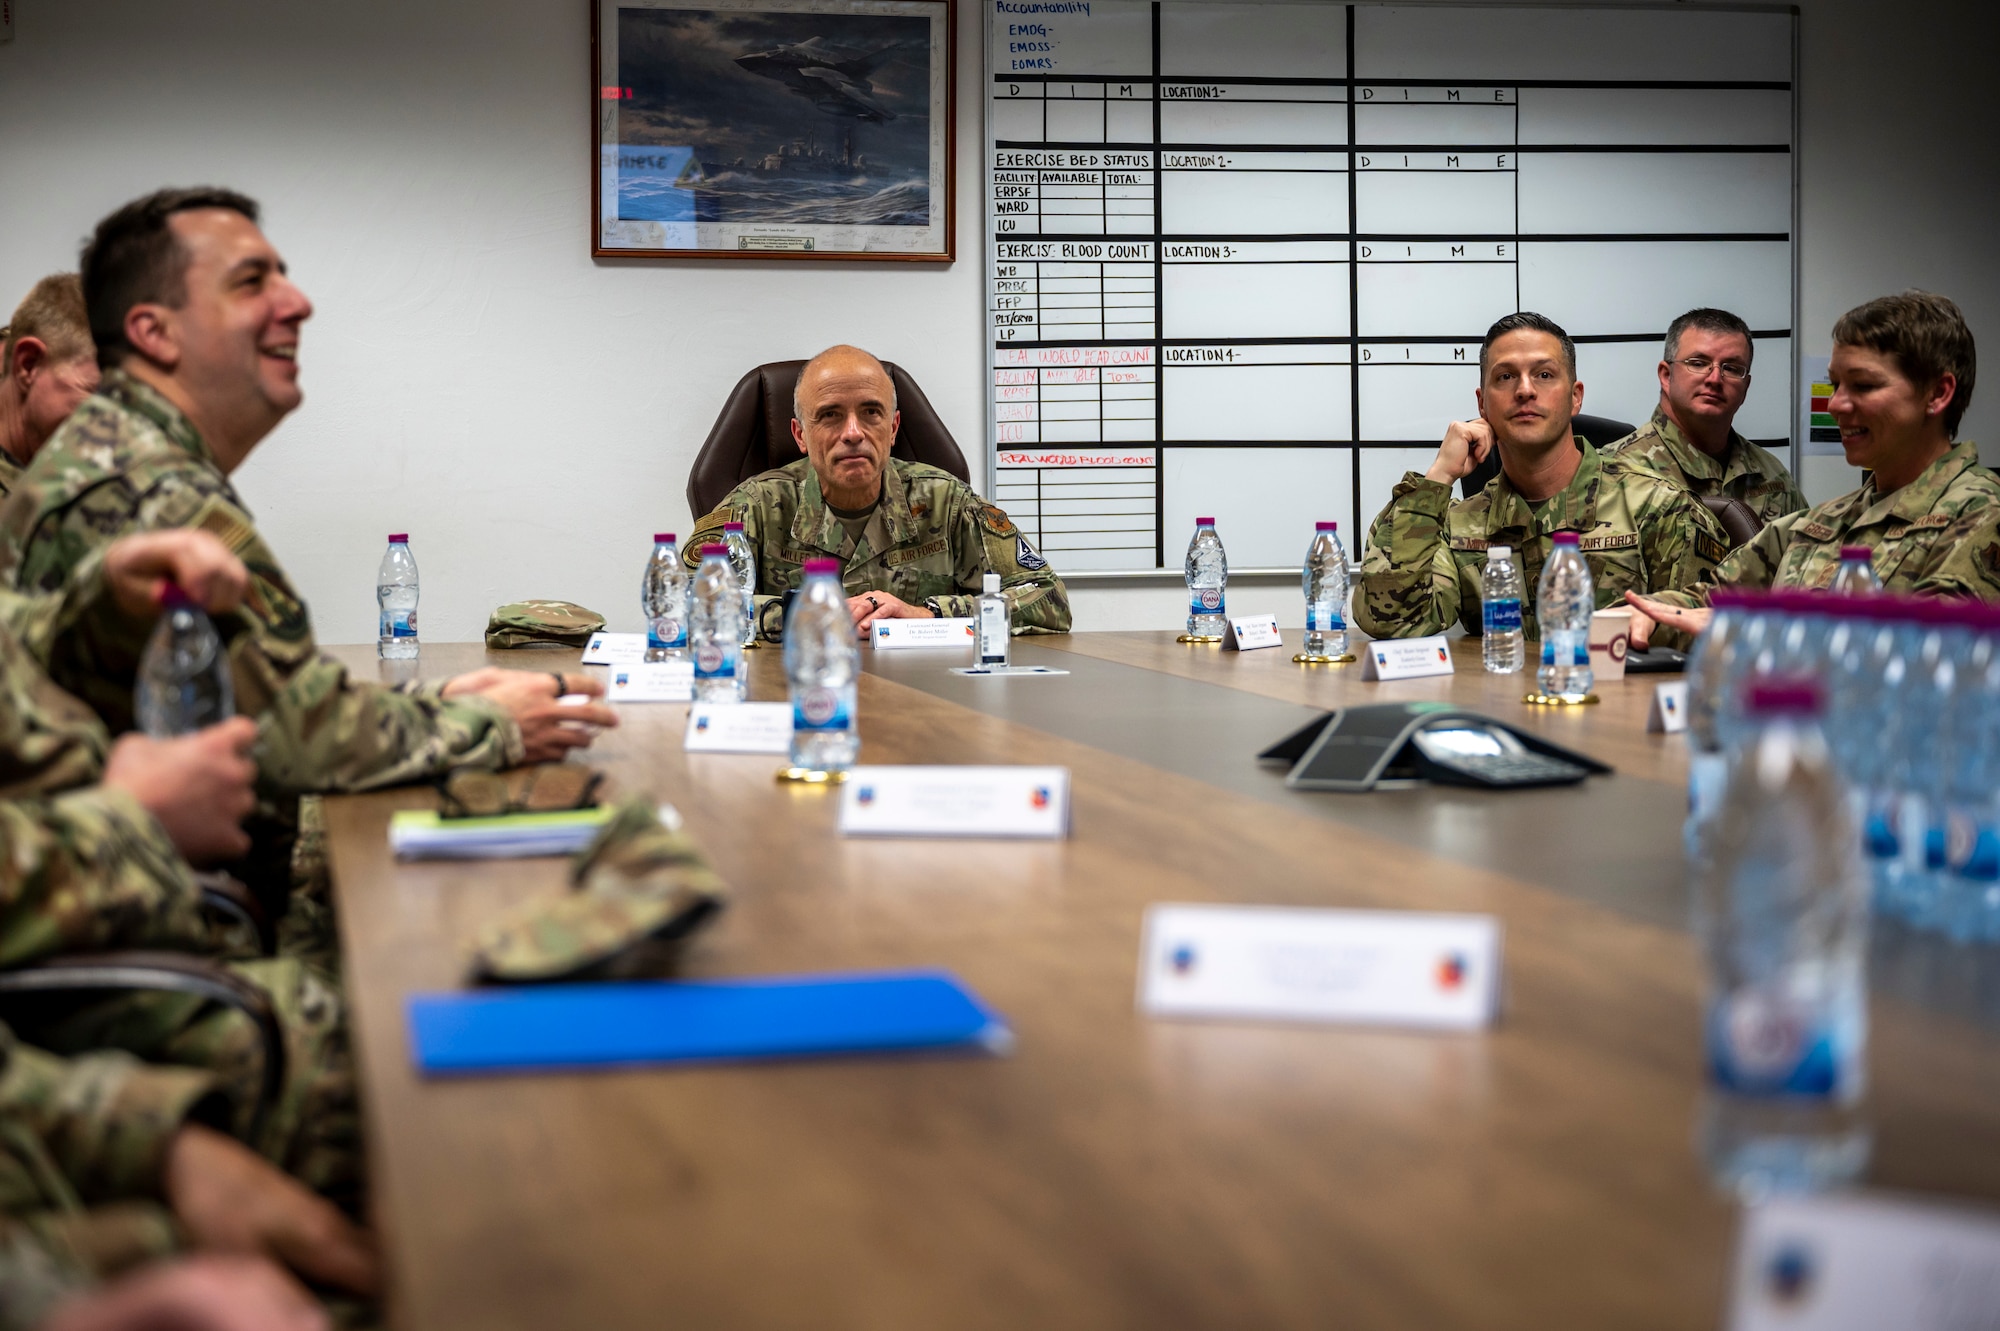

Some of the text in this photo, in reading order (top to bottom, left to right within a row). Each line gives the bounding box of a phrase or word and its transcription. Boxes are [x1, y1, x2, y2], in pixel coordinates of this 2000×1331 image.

[996, 1, 1090, 17] Accountability
[1010, 84, 1020, 96] D
[1120, 85, 1133, 97] M
[1363, 88, 1373, 100] D
[1447, 89, 1460, 101] M
[1494, 90, 1504, 101] E
[996, 153, 1150, 168] EXERCISE BED STATUS
[1164, 154, 1215, 168] LOCATION
[1361, 156, 1371, 168] D
[1447, 156, 1459, 168] M
[1497, 155, 1506, 168] E
[1041, 173, 1099, 183] AVAILABLE
[1107, 174, 1142, 184] TOTAL:
[995, 186, 1032, 198] ERPSF
[996, 201, 1029, 214] WARD
[997, 220, 1016, 232] ICU
[1062, 244, 1103, 258] BLOOD
[1108, 245, 1150, 259] COUNT
[1164, 246, 1220, 258] LOCATION
[1362, 246, 1372, 258] D
[1451, 245, 1464, 257] M
[1496, 245, 1505, 256] E
[997, 281, 1028, 293] PRBC
[997, 296, 1022, 309] FFP
[1000, 329, 1015, 340] LP
[1166, 348, 1224, 362] LOCATION
[1363, 349, 1371, 361] D
[1454, 348, 1465, 361] M
[1583, 534, 1638, 549] AIR FORCE
[901, 550, 916, 562] AIR
[917, 540, 947, 559] FORCE
